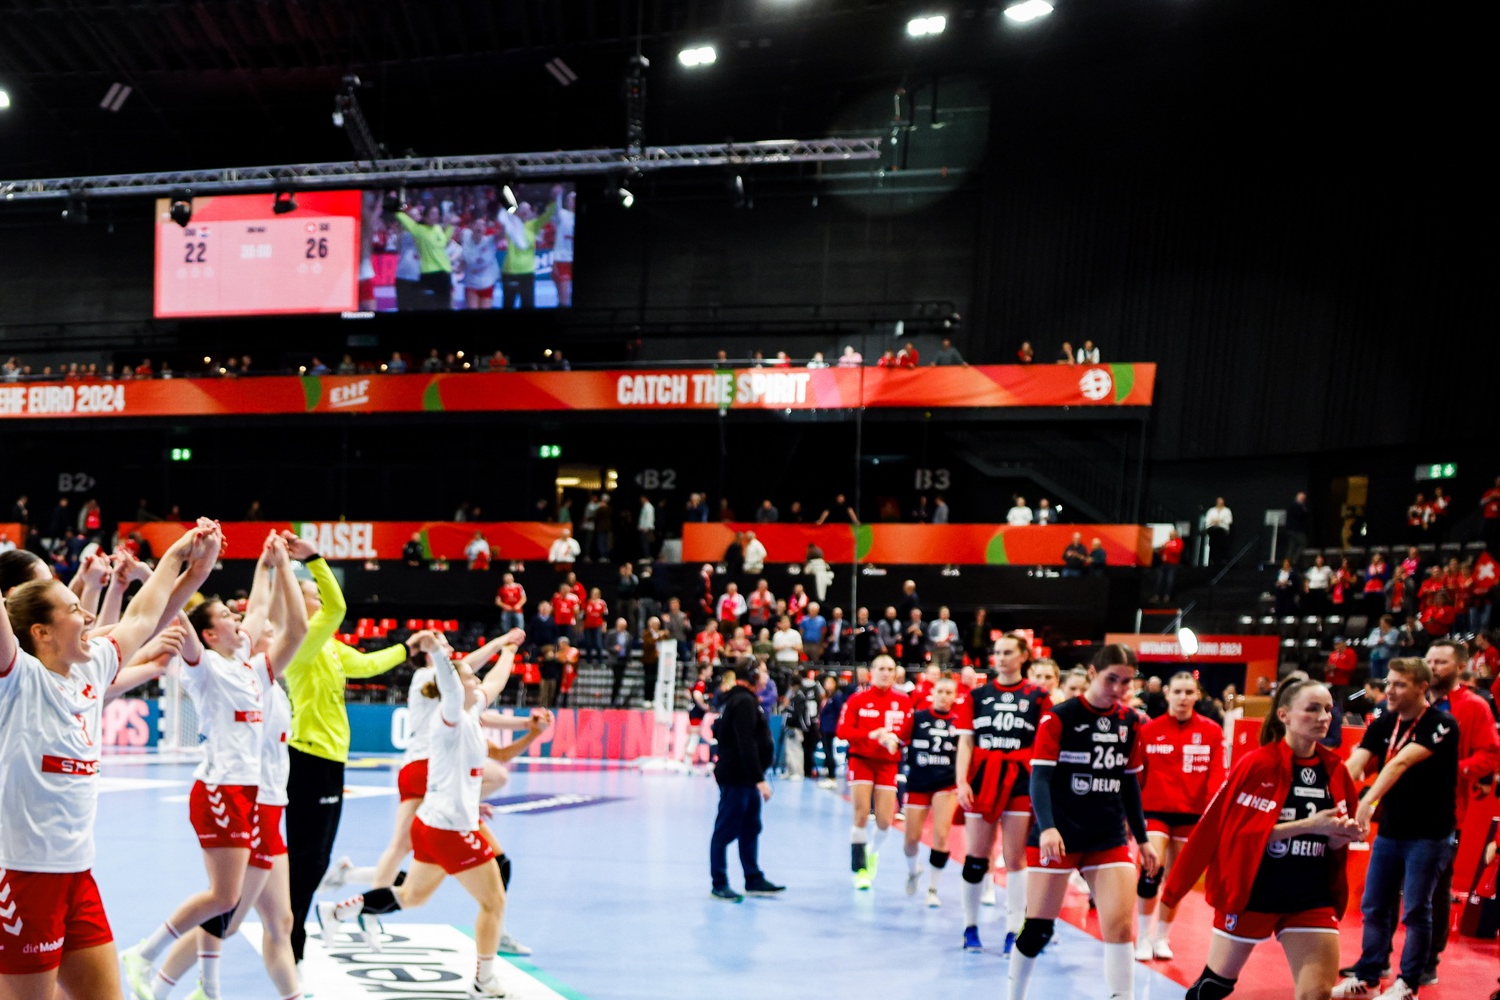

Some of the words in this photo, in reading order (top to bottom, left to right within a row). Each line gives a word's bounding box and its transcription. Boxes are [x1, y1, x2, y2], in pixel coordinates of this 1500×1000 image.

[185, 242, 207, 263] 22
[306, 237, 328, 259] 26
[28, 385, 75, 414] EURO
[76, 384, 126, 412] 2024
[617, 374, 688, 405] CATCH
[692, 373, 735, 405] THE
[736, 372, 811, 404] SPIRIT
[58, 472, 88, 492] B2
[643, 469, 677, 489] B2
[915, 469, 951, 490] B3
[301, 522, 378, 559] BASEL
[992, 712, 1014, 731] 40
[932, 736, 942, 752] 2
[1092, 745, 1116, 770] 26
[1251, 797, 1277, 813] HEP
